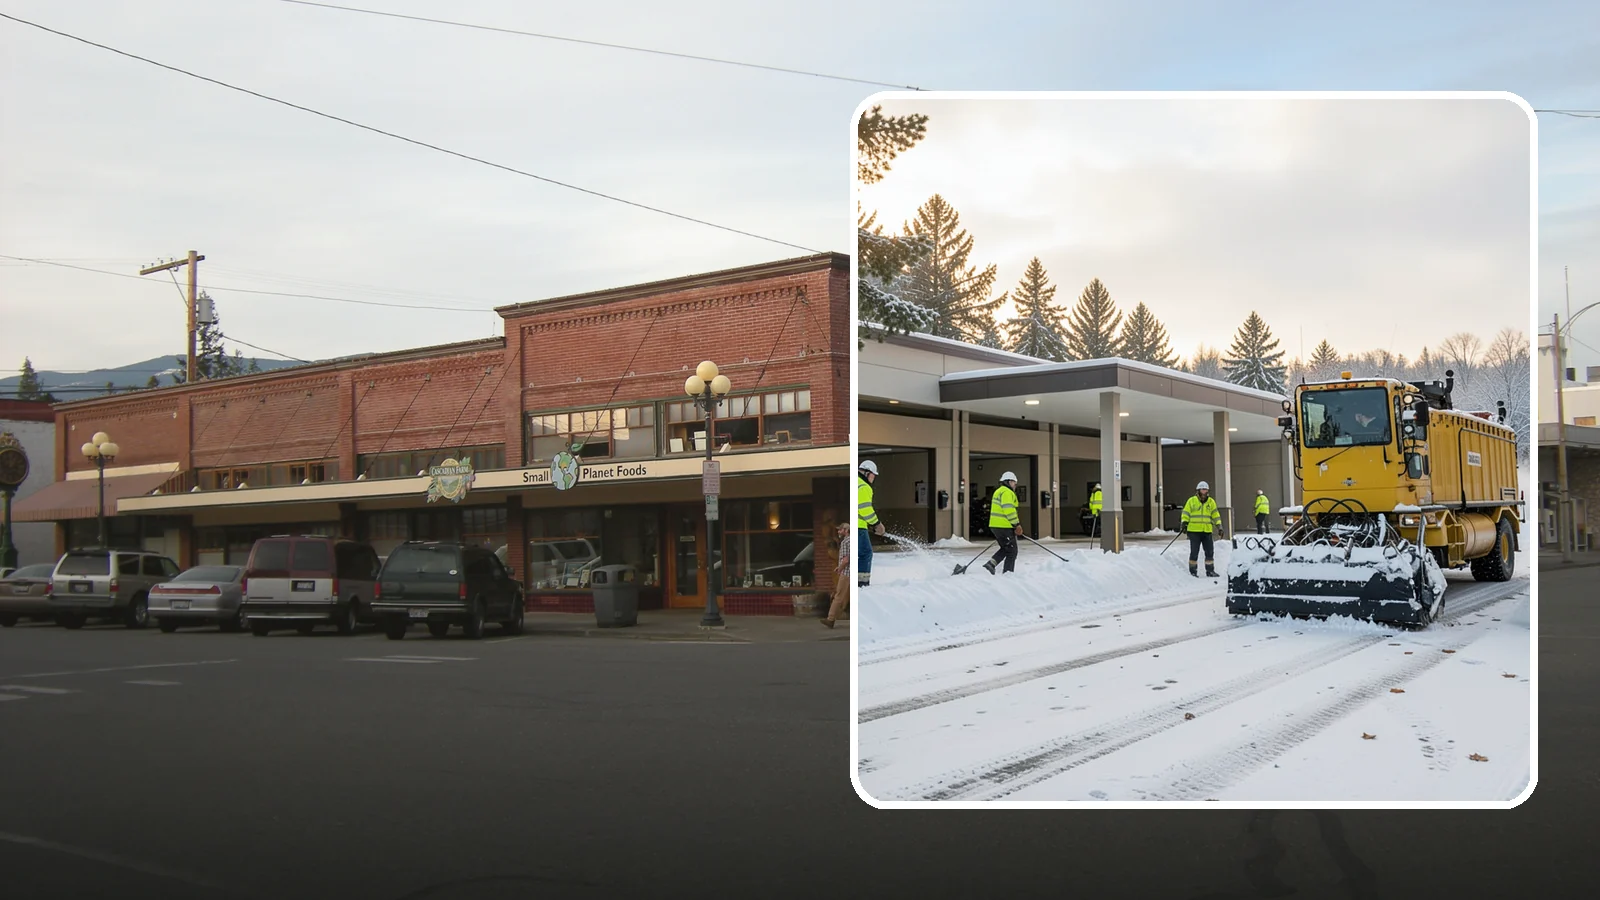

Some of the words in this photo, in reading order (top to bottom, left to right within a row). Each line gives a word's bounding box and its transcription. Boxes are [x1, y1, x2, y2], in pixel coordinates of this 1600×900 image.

[523, 471, 549, 483] Small
[583, 467, 614, 480] Planet
[617, 464, 647, 477] Foods
